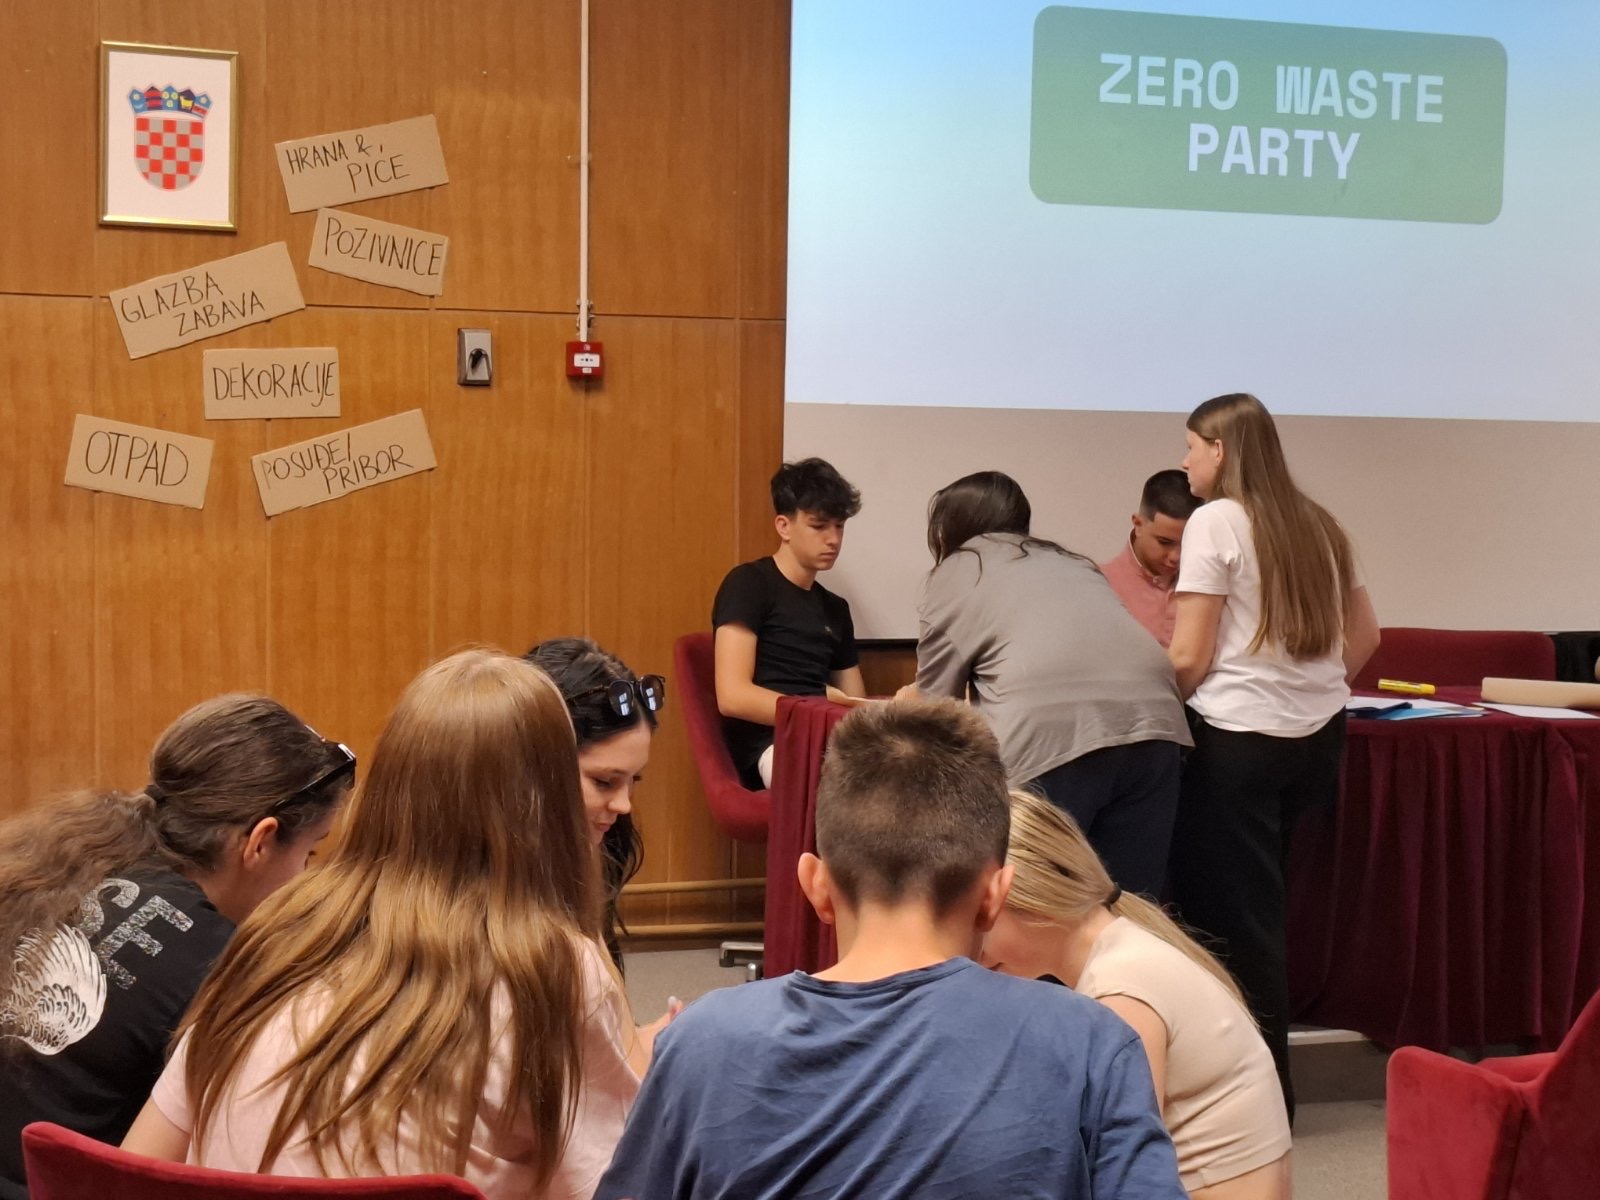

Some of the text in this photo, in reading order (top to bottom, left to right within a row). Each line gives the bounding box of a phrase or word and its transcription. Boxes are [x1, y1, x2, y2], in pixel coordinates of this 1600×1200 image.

[1099, 53, 1444, 123] ZERO WASTE
[286, 134, 373, 175] HRANA &
[1188, 123, 1361, 180] PARTY
[324, 217, 444, 276] POZIVNICE
[120, 272, 224, 324] GLAZBA
[173, 291, 265, 337] ZABAVA
[213, 361, 337, 408] DEKORACIJE
[85, 430, 189, 487] OTPAD
[322, 444, 414, 495] PRIBOR
